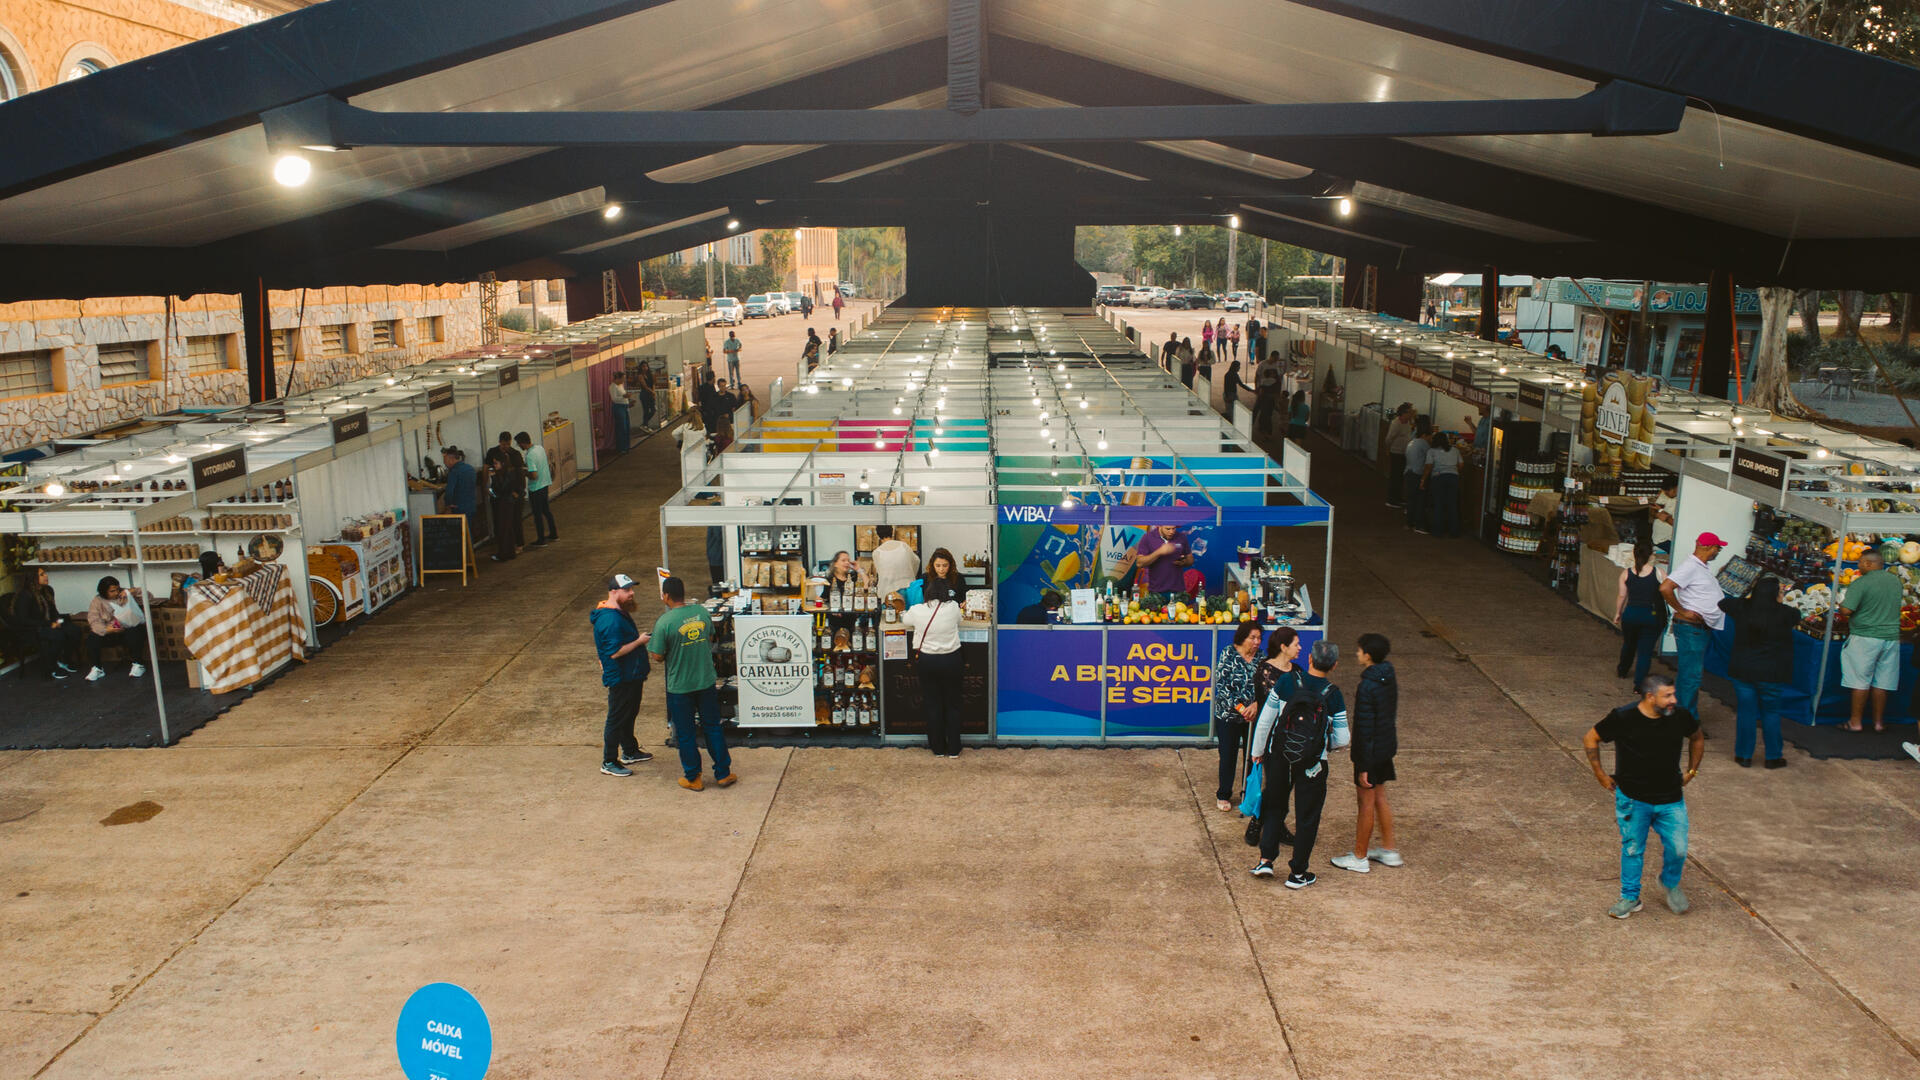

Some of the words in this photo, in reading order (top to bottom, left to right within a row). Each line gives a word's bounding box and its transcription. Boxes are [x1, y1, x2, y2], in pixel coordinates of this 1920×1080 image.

[1674, 291, 1708, 311] LOJ
[1597, 408, 1630, 434] DINEI
[202, 459, 236, 477] VITORIANO
[1738, 458, 1754, 470] LICOR
[1755, 463, 1779, 477] IMPORTS
[1003, 505, 1054, 522] WiBA!
[1110, 527, 1136, 550] W
[748, 630, 800, 648] CACHAÇARIA
[1126, 643, 1199, 662] AQUI,
[740, 665, 809, 678] CARVALHO
[1050, 665, 1070, 681] A
[1076, 665, 1212, 682] BRINCAD
[1107, 682, 1127, 703] É
[427, 1020, 462, 1039] CAIXA
[422, 1038, 462, 1059] MÓVEL
